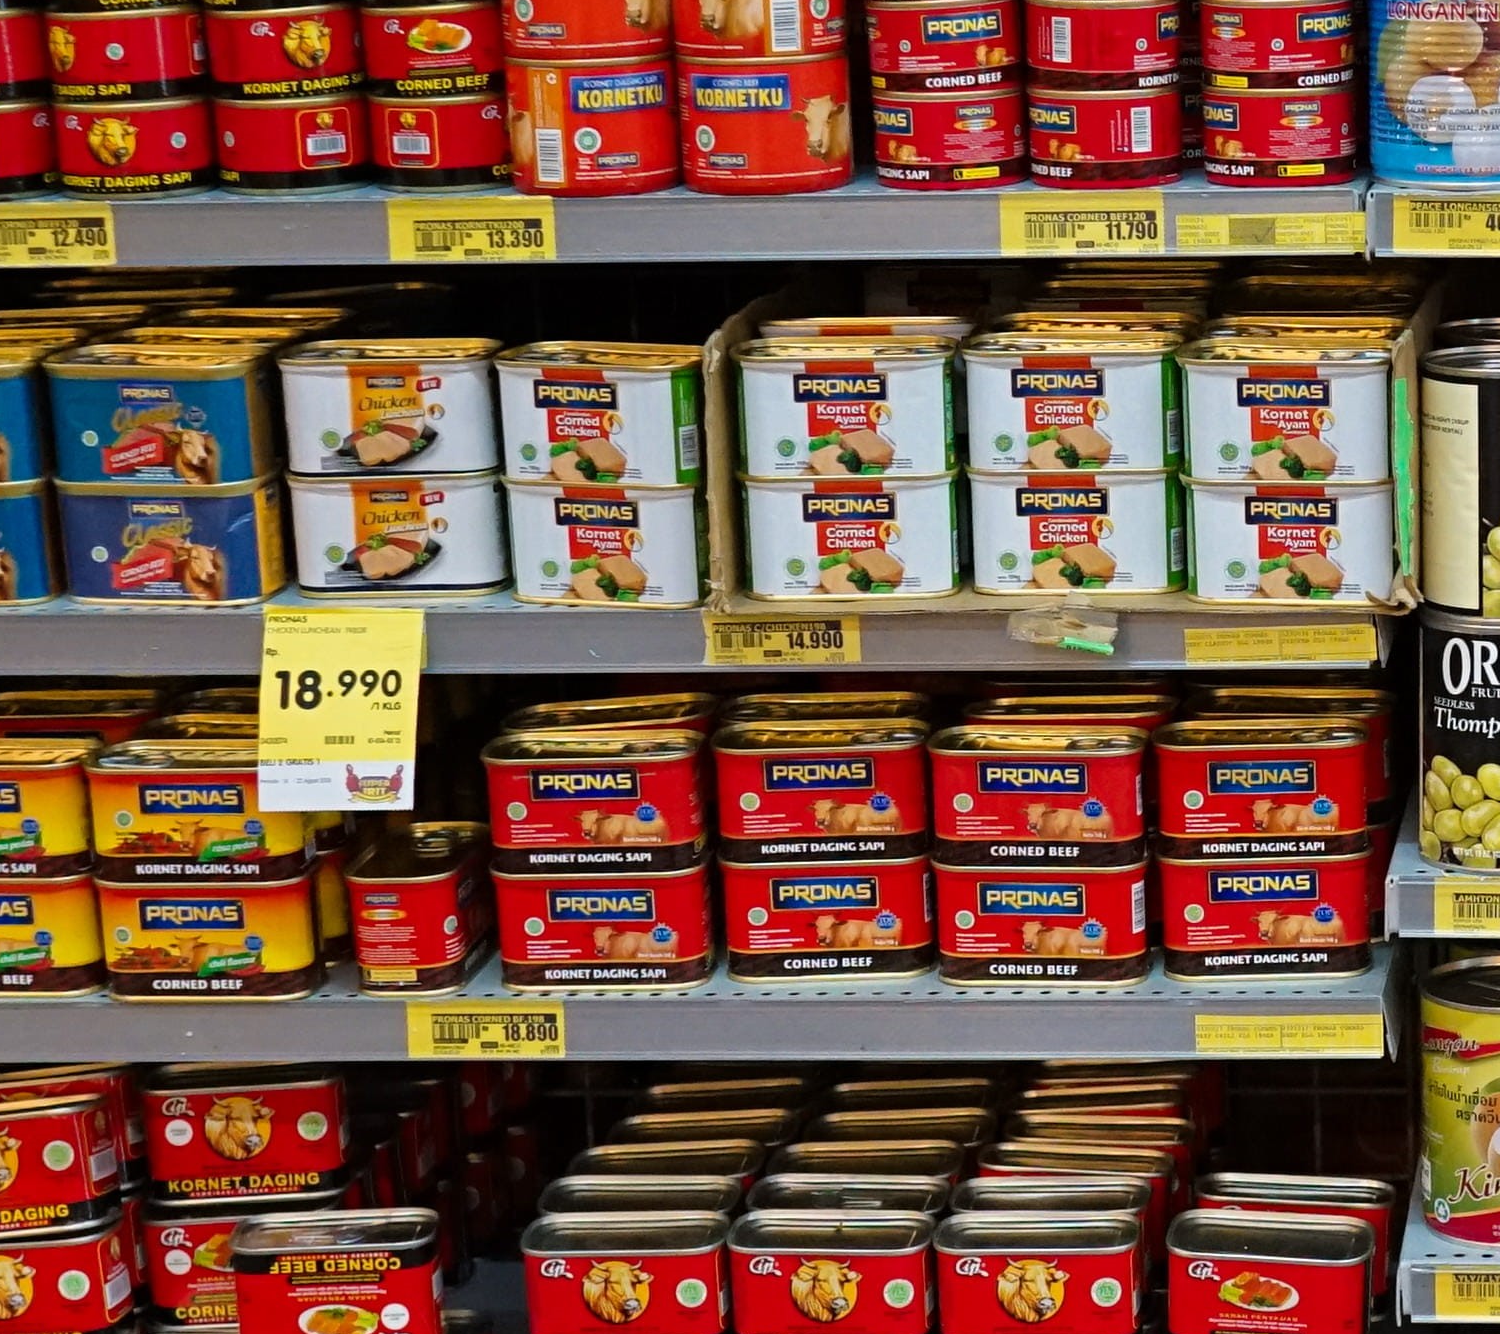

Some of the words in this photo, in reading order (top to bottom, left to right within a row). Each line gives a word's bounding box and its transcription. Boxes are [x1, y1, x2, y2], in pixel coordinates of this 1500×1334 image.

[244, 82, 298, 95] KORNET
[302, 77, 348, 91] DAGING
[926, 75, 974, 88] CORNED
[978, 72, 1002, 84] BEEF
[577, 85, 663, 106] KORNETKU
[1024, 213, 1064, 222] PRONAS
[1067, 213, 1106, 222] CORNED
[1109, 213, 1145, 222] BEF120
[51, 229, 107, 248] 12.490
[487, 229, 544, 247] 13.390
[1104, 221, 1157, 239] 11.790
[800, 378, 879, 395] PRONAS
[817, 404, 864, 415] Kornet
[836, 415, 866, 429] Ayam
[786, 632, 843, 650] 14.990
[274, 671, 402, 709] 18.990
[1205, 955, 1251, 967] KORNET
[1255, 953, 1298, 965] DAGING
[1302, 953, 1327, 964] SAPI
[501, 1025, 558, 1043] 18.890
